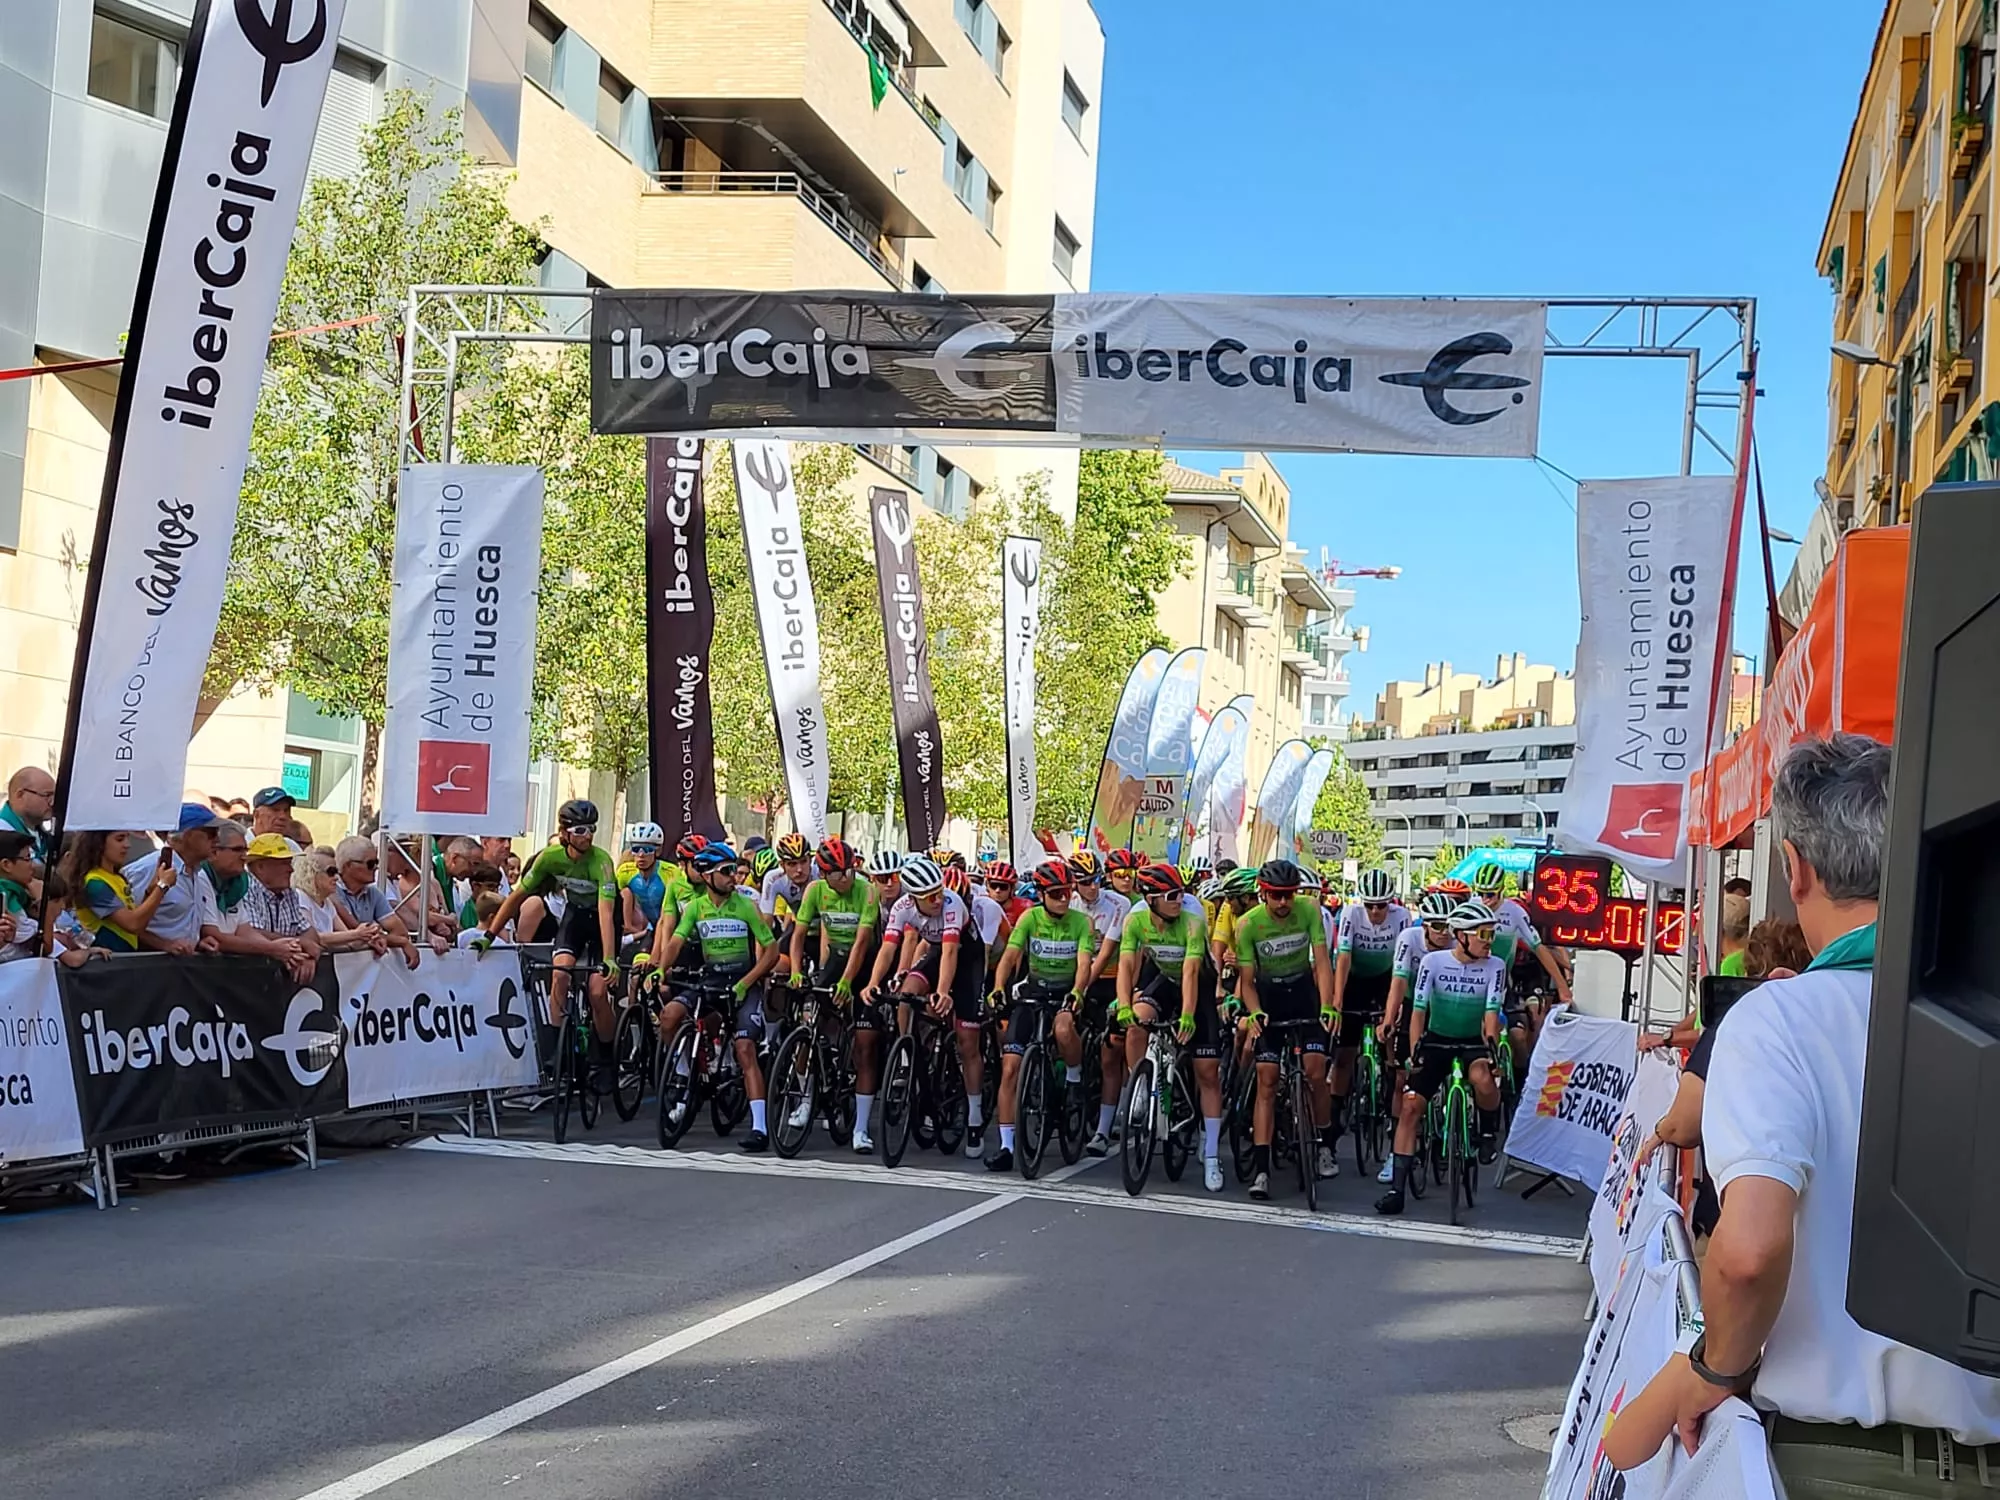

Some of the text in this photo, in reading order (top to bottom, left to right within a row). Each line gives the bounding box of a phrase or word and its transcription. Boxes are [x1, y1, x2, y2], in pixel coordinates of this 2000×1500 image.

[161, 130, 277, 430] iberCaja
[610, 327, 872, 389] iberCaja
[1075, 331, 1353, 405] iberCaja
[420, 484, 464, 729] Ayuntamiento
[766, 526, 806, 671] iberCaja
[462, 545, 502, 732] de Huesca
[892, 573, 920, 703] iberCaja
[1615, 500, 1652, 772] Ayuntamiento
[1653, 564, 1696, 772] de Huesca
[115, 674, 146, 761] BANCO
[113, 769, 132, 799] EL
[682, 768, 694, 823] BANCO
[806, 772, 817, 797] DEL
[923, 787, 931, 809] DEL
[1538, 865, 1600, 914] 35
[350, 989, 478, 1053] iberCaja
[1445, 984, 1475, 994] ALEA
[81, 1003, 254, 1078] iberCaja
[1558, 1092, 1583, 1122] DE
[1578, 1096, 1623, 1140] ARAG
